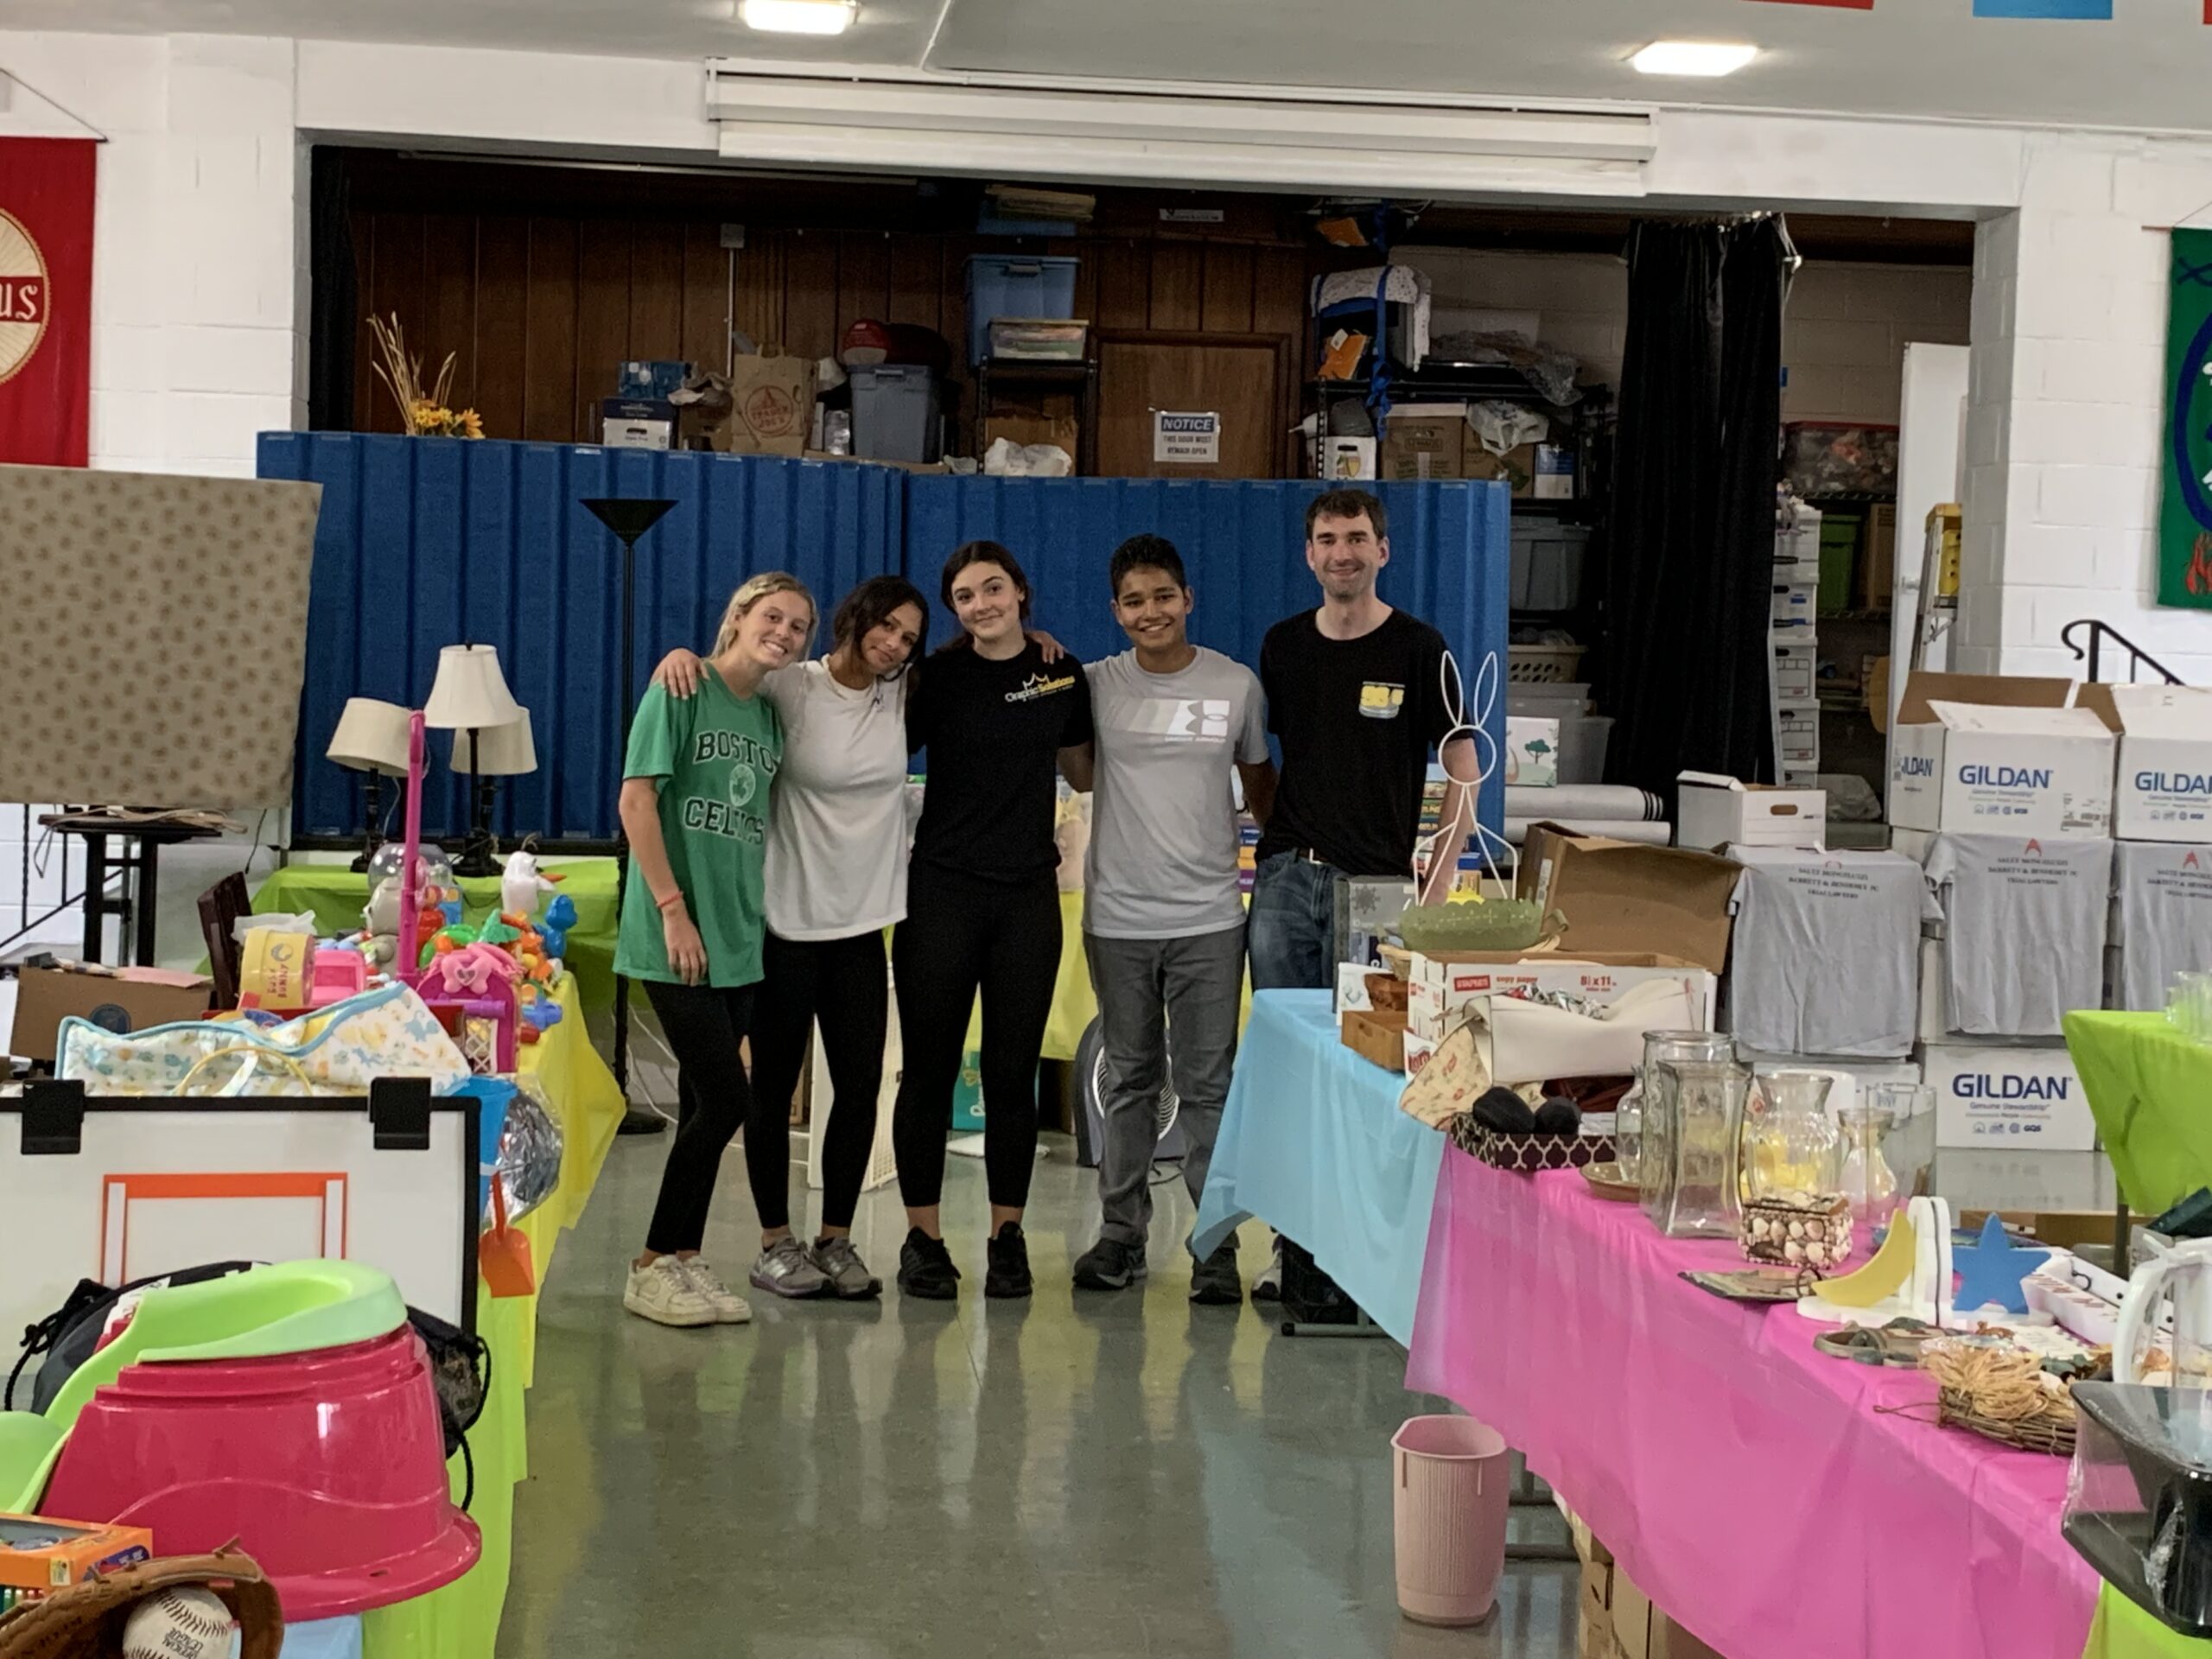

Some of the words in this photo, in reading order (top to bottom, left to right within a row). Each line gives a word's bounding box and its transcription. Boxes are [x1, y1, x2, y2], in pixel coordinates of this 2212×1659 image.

[1163, 418, 1212, 431] NOTICE
[1959, 765, 2050, 789] GILDAN
[1953, 1074, 2068, 1100] GILDAN
